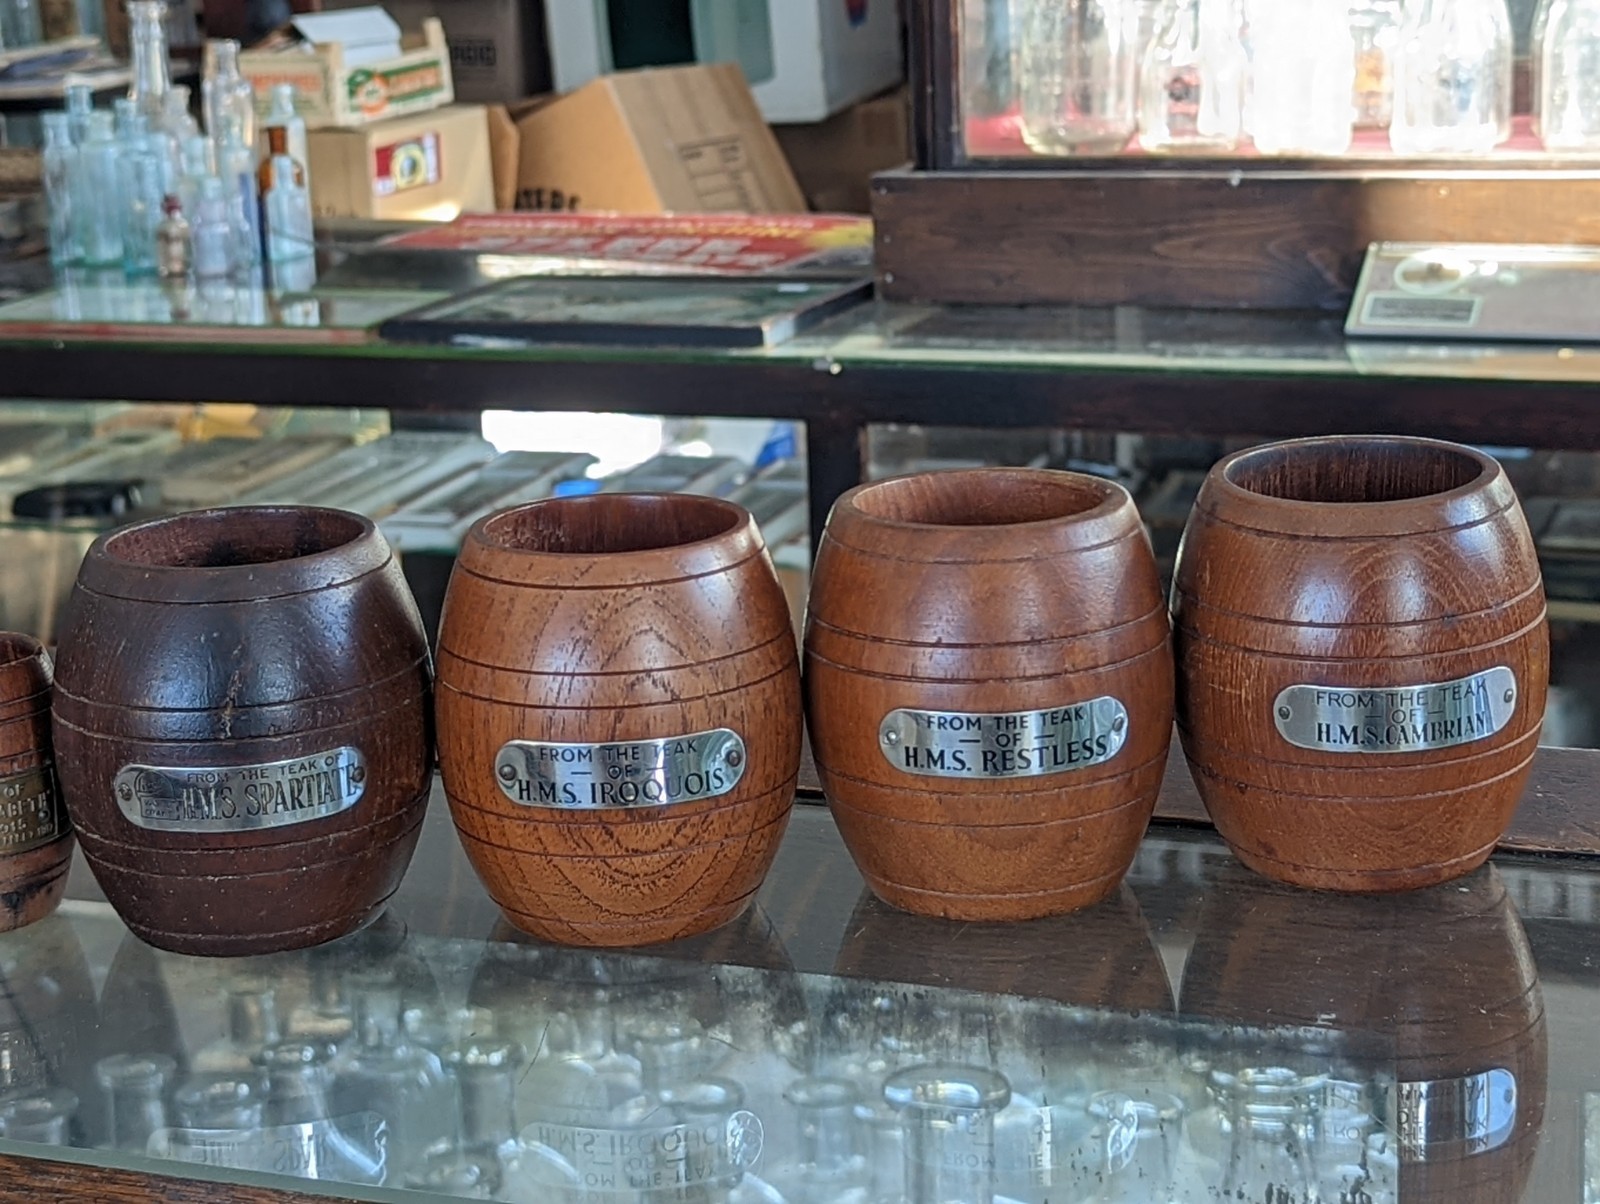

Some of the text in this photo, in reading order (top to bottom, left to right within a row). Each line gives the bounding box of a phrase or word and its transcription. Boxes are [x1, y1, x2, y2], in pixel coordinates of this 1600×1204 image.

[1316, 677, 1489, 708] FROM THE TEAK
[927, 706, 1084, 731] FROM THE TEAK
[1392, 709, 1420, 723] OF
[540, 739, 698, 763] FROM THE TEAK
[904, 735, 1107, 772] H.M.S. RESTLESS
[996, 733, 1022, 748] OF
[187, 752, 343, 783] FROM THE TEAK OF
[607, 765, 633, 780] OF
[244, 762, 362, 816] SPARTIATE
[518, 768, 725, 804] H.M.S. IROQUOIS
